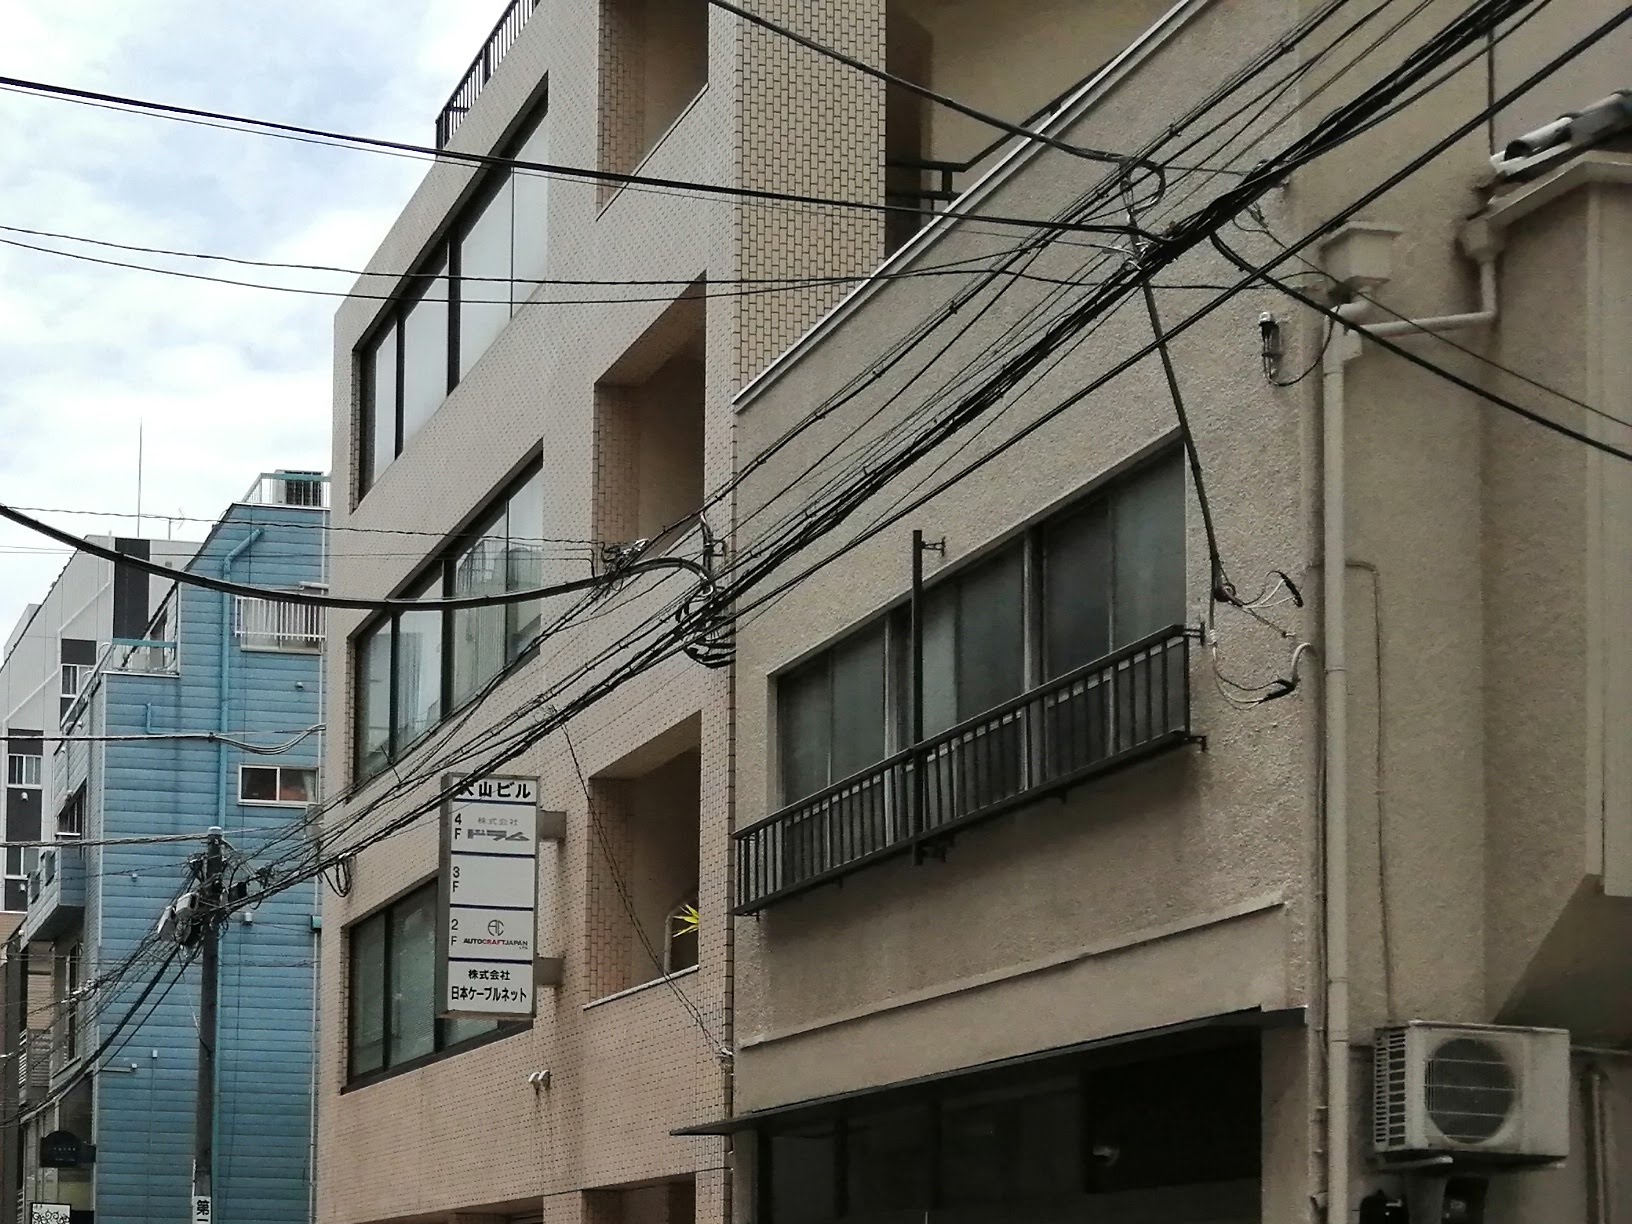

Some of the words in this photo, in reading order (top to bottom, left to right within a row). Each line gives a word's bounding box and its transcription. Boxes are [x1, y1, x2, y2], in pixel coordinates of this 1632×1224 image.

[478, 817, 518, 826] 株式会社
[468, 969, 510, 980] 株式会社
[451, 985, 527, 1003] 日本ケーブルネット
